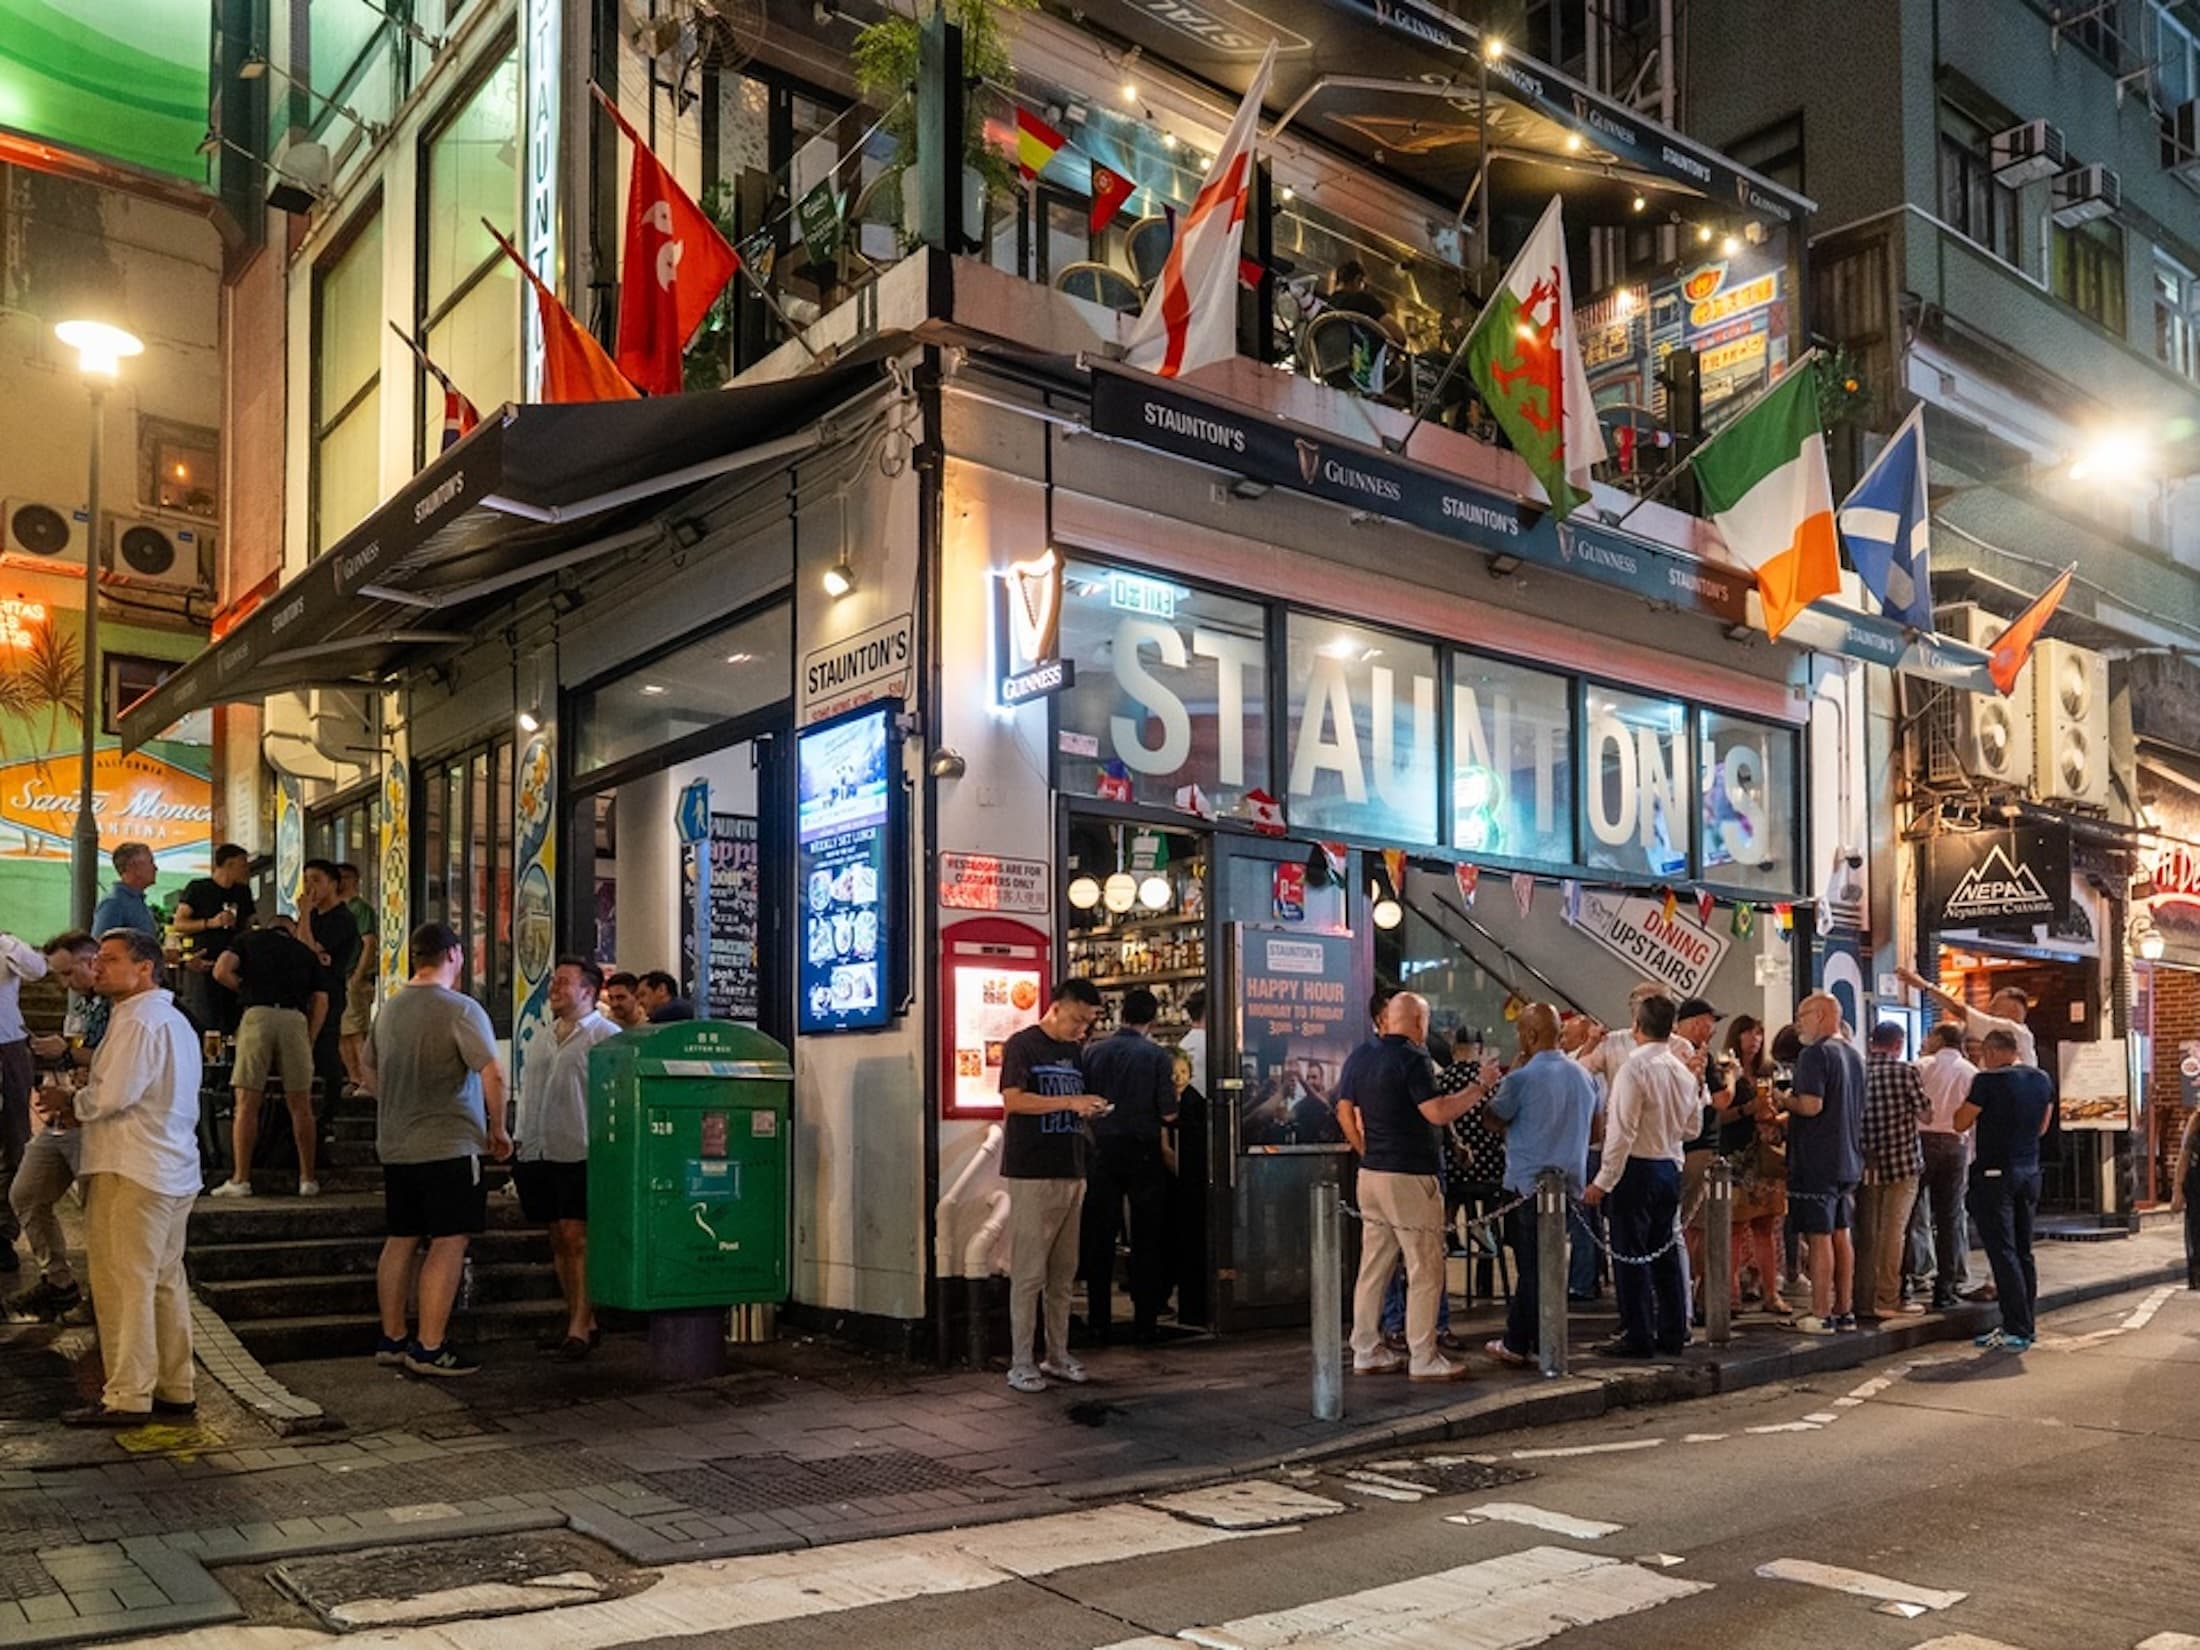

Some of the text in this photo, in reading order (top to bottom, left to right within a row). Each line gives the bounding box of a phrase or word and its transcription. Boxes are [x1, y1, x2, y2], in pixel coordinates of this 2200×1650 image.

[1144, 402, 1246, 452] STAUNTON'S
[1324, 459, 1401, 501] GUINNESS
[414, 471, 465, 523] STAUNTON'S
[1442, 496, 1519, 536] STAUNTON'S
[1578, 540, 1638, 575] GUINNESS
[1669, 568, 1730, 602] STAUNTON'S
[808, 630, 906, 695] STAUNTON'S
[1003, 662, 1063, 699] GUINNESS
[97, 757, 163, 776] ALIFORNIA
[97, 822, 168, 839] ANTINA
[1006, 863, 1022, 876] ARE
[1025, 865, 1041, 877] FOR
[1013, 878, 1035, 890] ONLY
[1958, 881, 2037, 901] NEPAL
[2002, 901, 2055, 915] Cuisine
[1269, 943, 1322, 959] STAUNTON'S
[1643, 909, 1711, 966] DINING
[1610, 918, 1698, 991] UPSTAIRS
[1246, 977, 1345, 1003] HAPPY HOUR
[1247, 1002, 1345, 1021] MONDAY TO FRIDAY
[1269, 1020, 1294, 1036] 3pm
